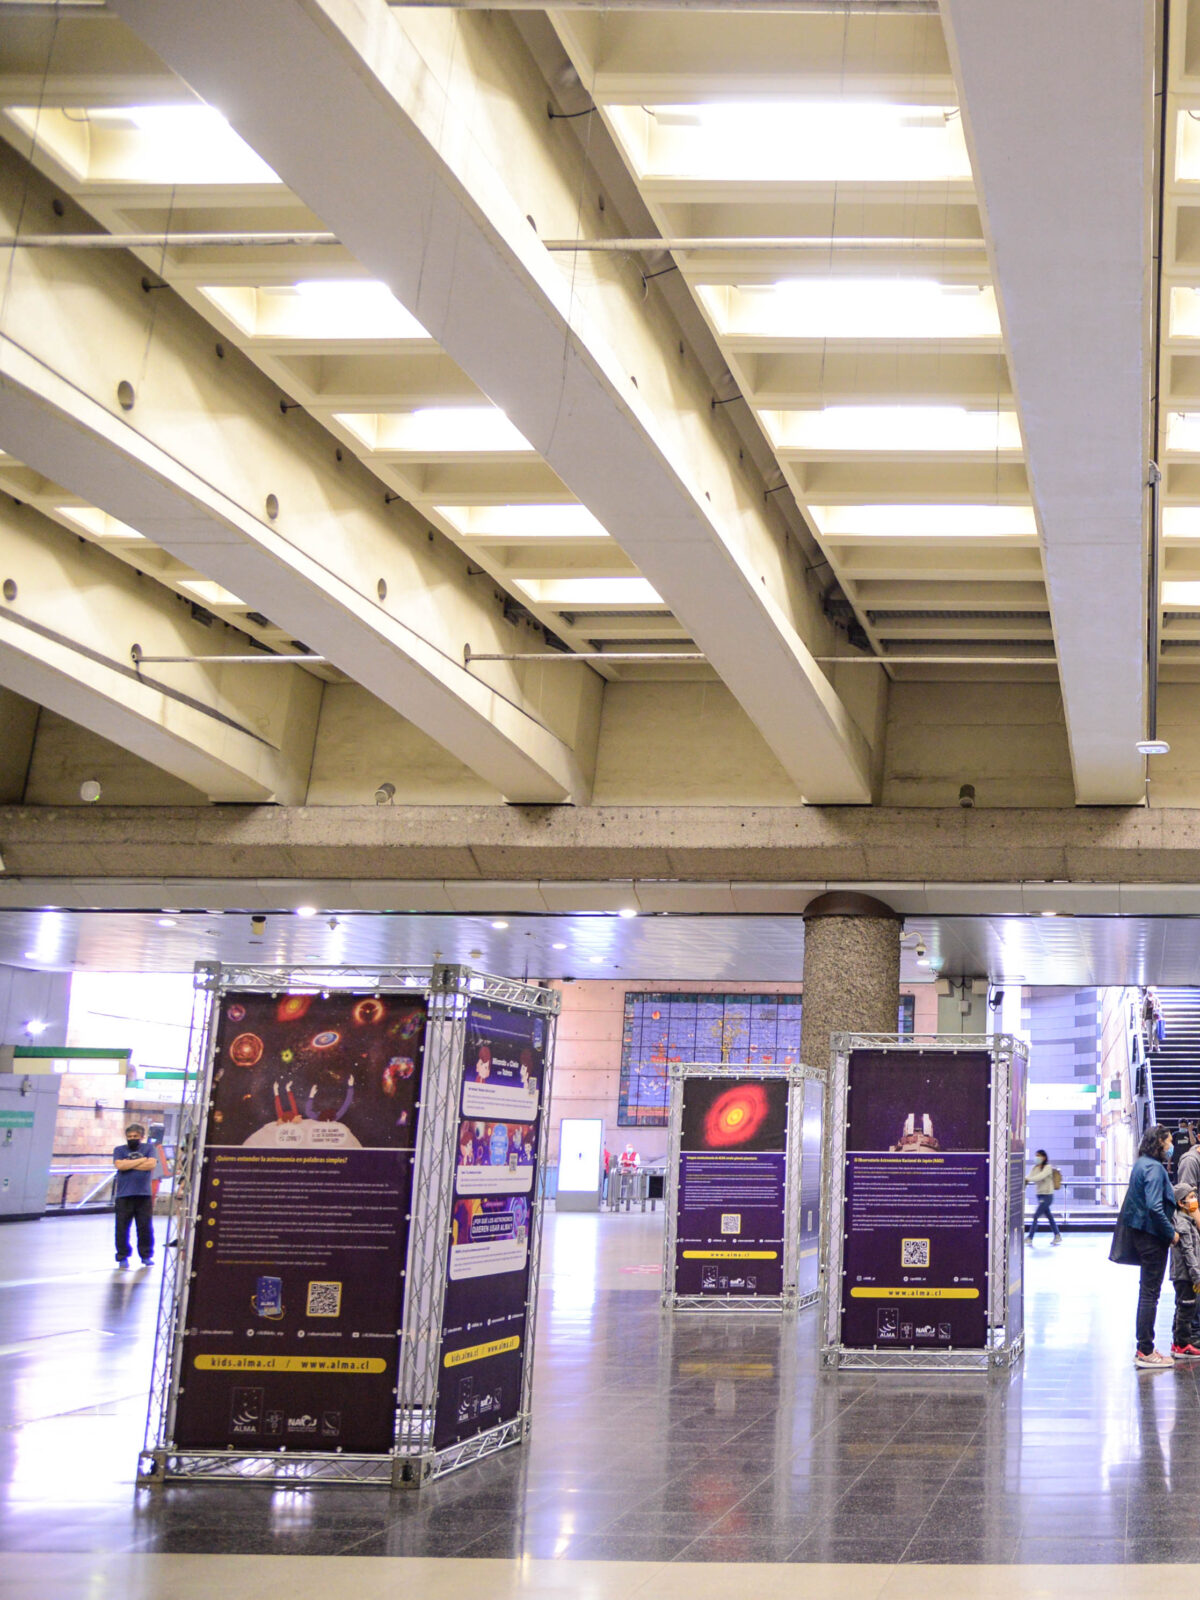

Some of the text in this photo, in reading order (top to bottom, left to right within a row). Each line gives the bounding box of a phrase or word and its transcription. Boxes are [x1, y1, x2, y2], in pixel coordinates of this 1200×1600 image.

[888, 1289, 942, 1297] www.alma.cl
[211, 1357, 276, 1368] kids.alma.cl
[301, 1360, 370, 1370] www.alma.cl
[233, 1425, 257, 1433] ALMA
